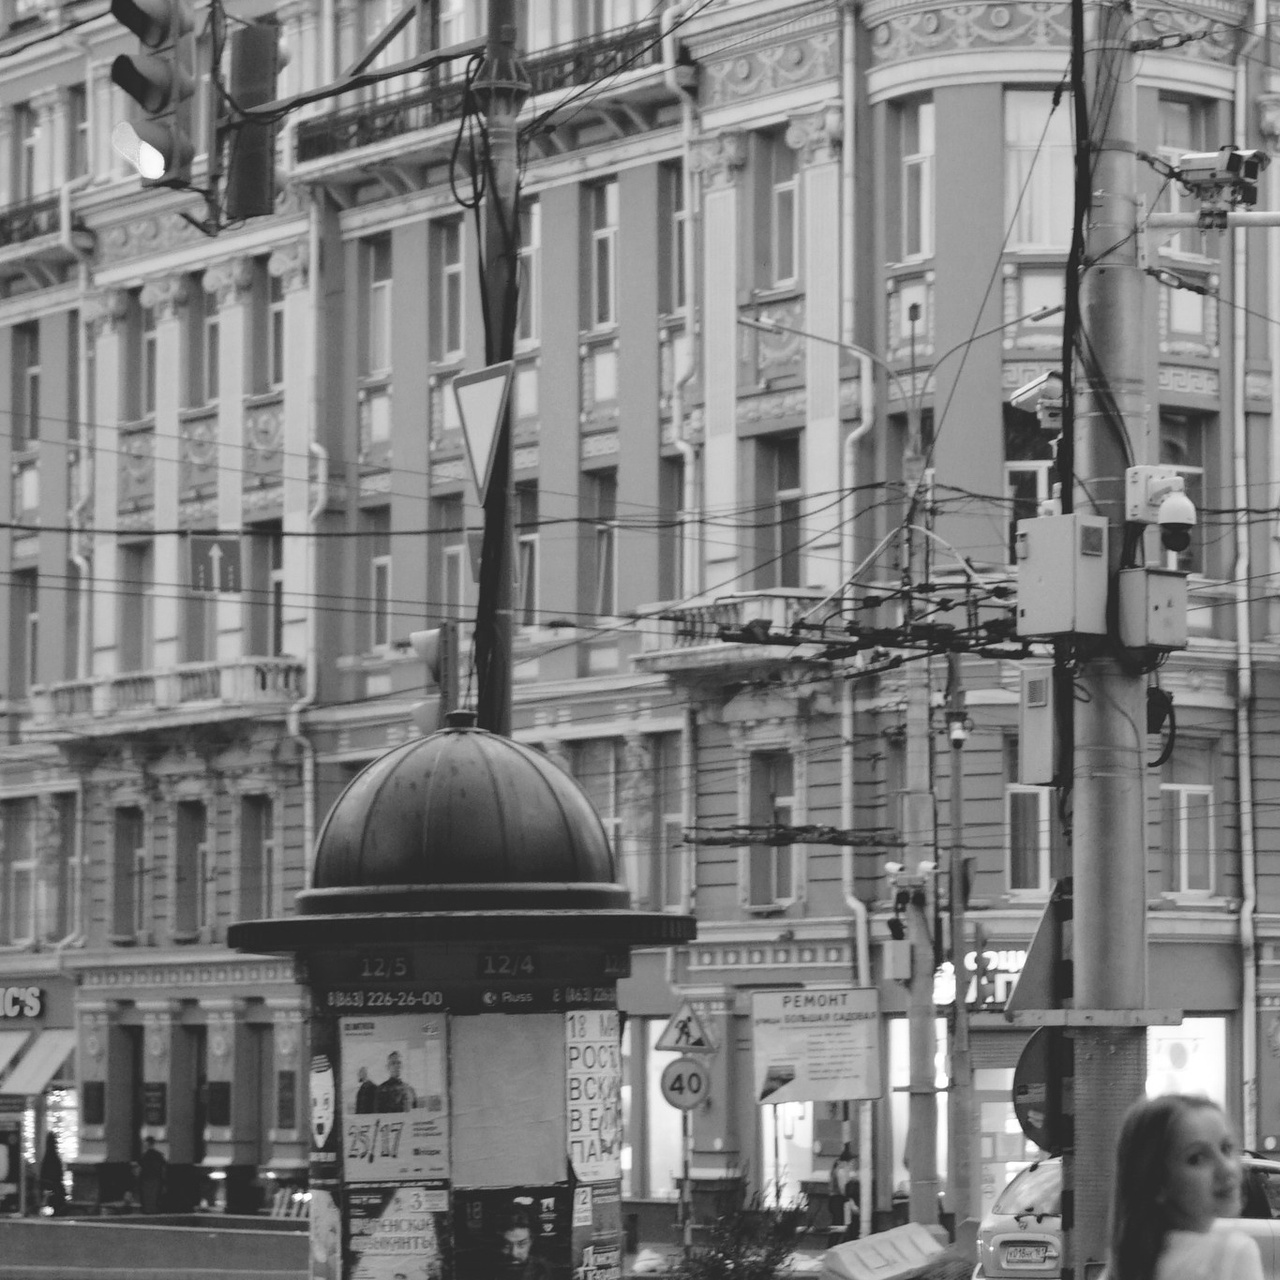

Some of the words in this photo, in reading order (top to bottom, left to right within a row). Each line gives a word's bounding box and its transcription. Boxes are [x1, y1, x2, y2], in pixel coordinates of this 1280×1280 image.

[361, 958, 407, 977] 12/5
[484, 955, 535, 976] 12/4
[367, 991, 443, 1006] 226-26-00
[502, 991, 533, 1002] Russ
[782, 994, 848, 1008] РЕМОНТ
[568, 1015, 587, 1038] 18
[669, 1073, 702, 1095] 40
[348, 1119, 404, 1164] 25/17
